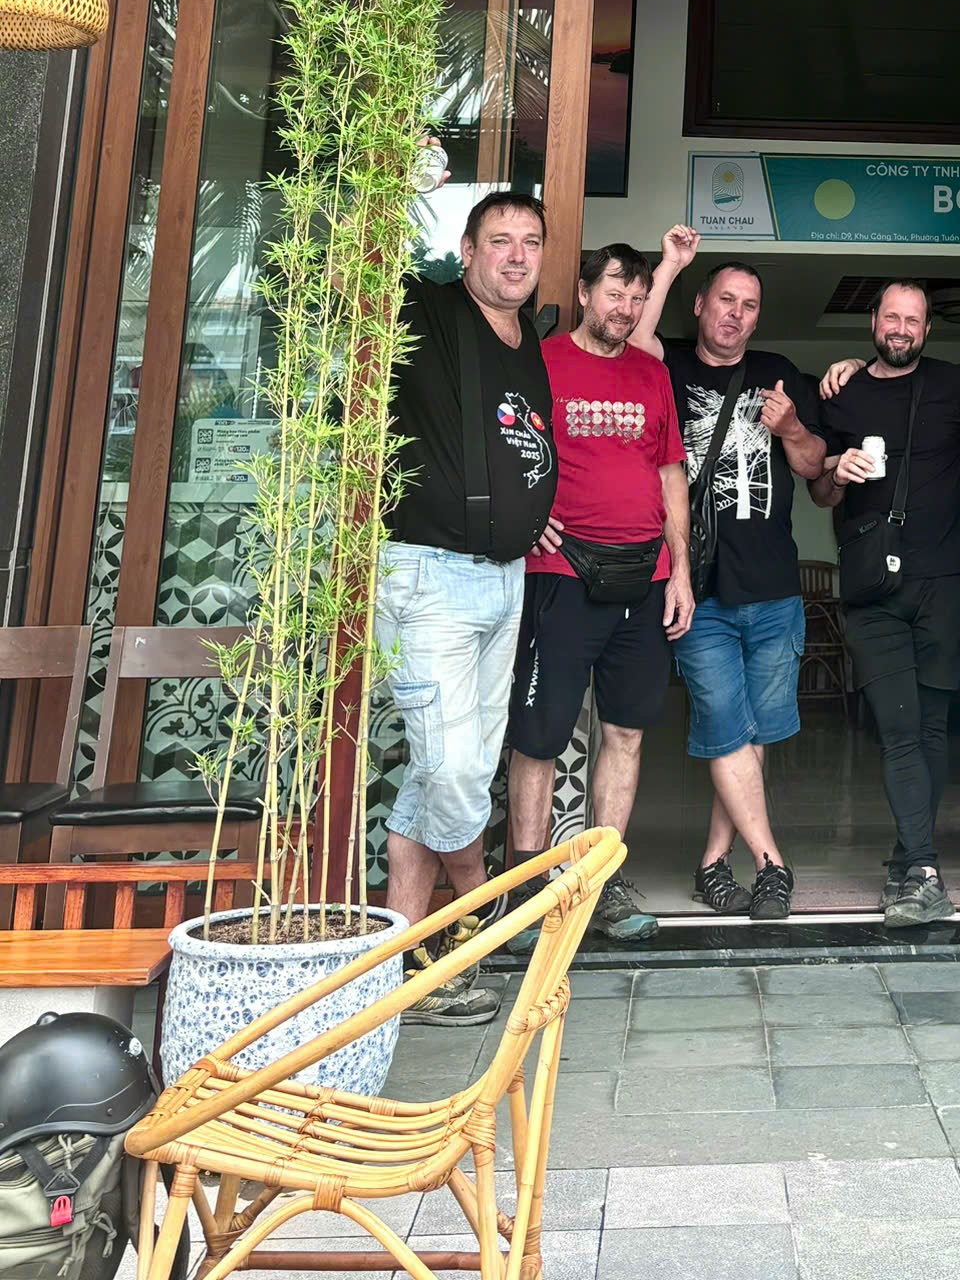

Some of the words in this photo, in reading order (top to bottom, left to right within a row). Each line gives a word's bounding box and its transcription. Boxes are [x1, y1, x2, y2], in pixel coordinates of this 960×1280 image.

[866, 162, 909, 177] CÔNG
[912, 166, 929, 177] TY
[700, 216, 726, 225] TUAN
[729, 216, 754, 225] CHAU
[521, 450, 540, 460] 2025
